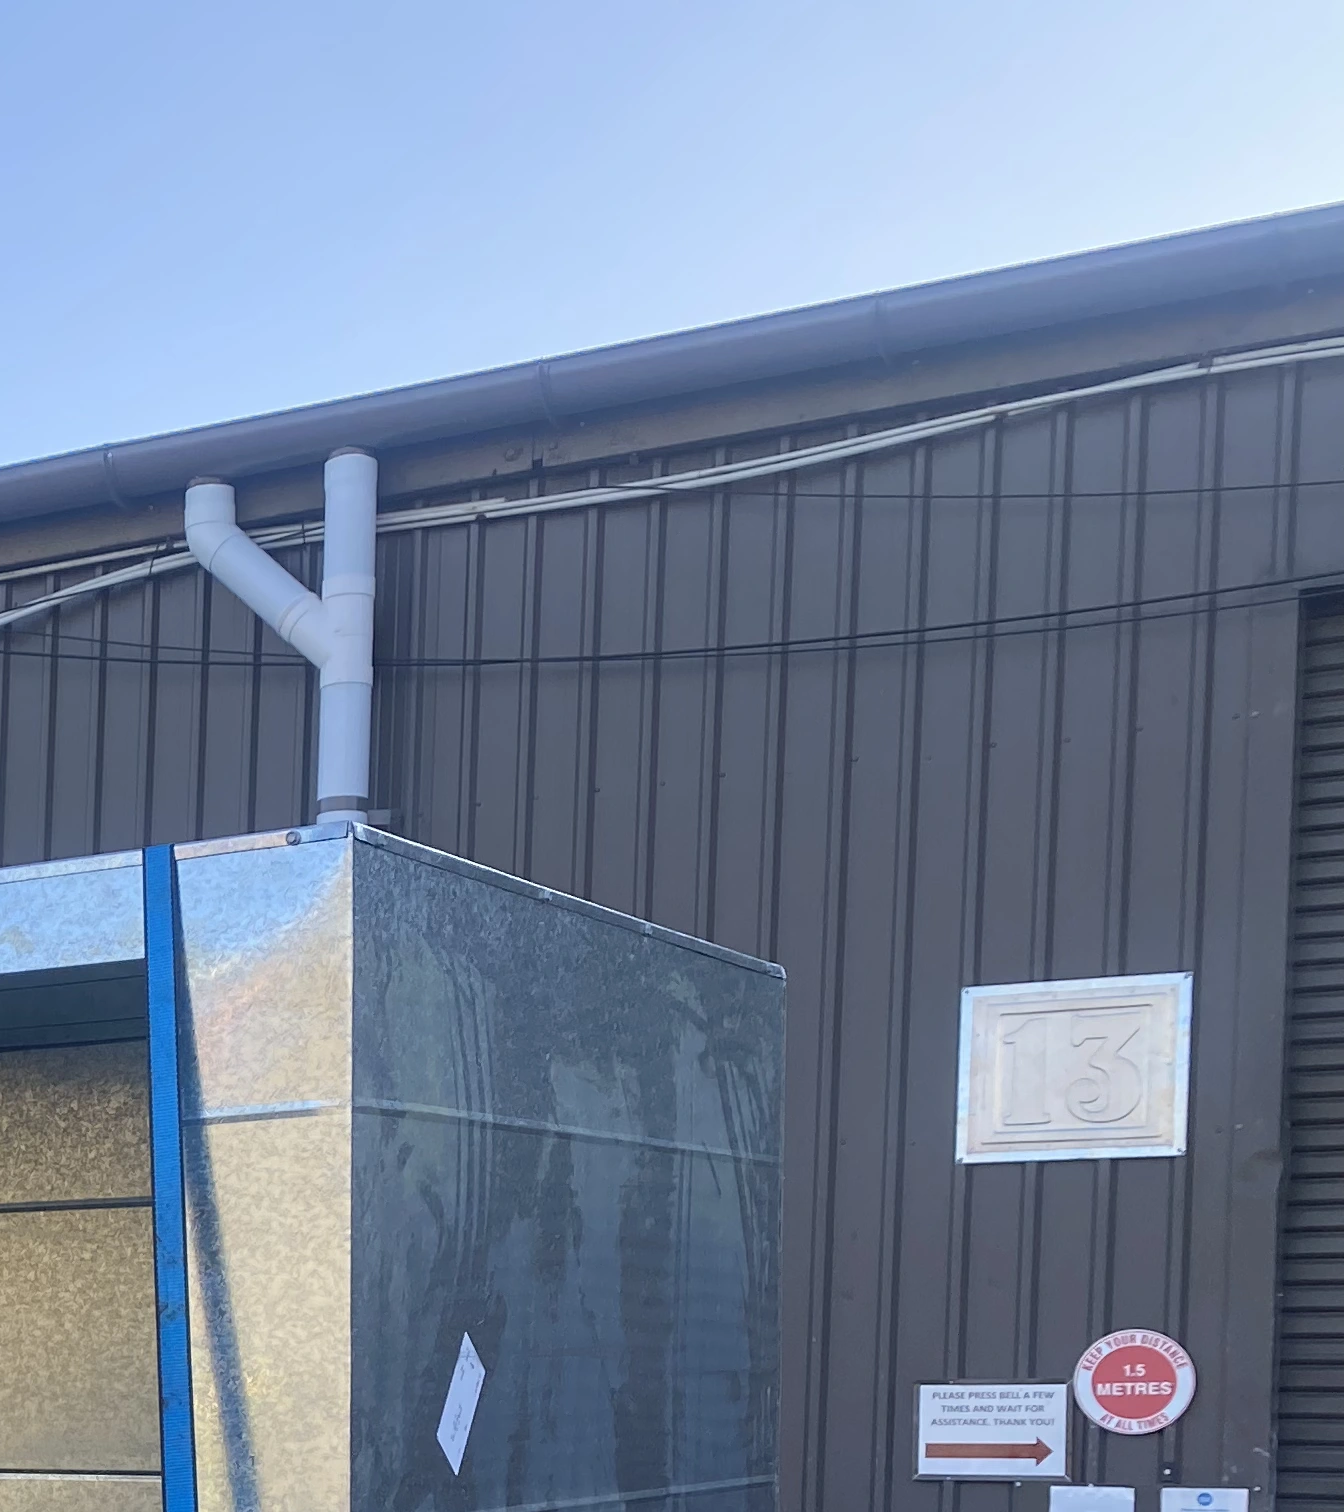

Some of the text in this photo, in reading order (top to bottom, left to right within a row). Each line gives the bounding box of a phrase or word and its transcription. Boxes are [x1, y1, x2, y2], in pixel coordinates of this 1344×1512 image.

[1001, 1012, 1143, 1125] 13
[1081, 1334, 1189, 1372] KEEP YOUR DISTANCE
[1123, 1363, 1147, 1377] 1.5
[932, 1391, 1055, 1400] PLEASE PRESS BELL A FEW
[1096, 1381, 1173, 1396] METRES
[941, 1404, 1045, 1412] TIMES AND WAIT FOR
[993, 1418, 1027, 1426] THANK
[1099, 1412, 1170, 1431] AT ALL TIMES
